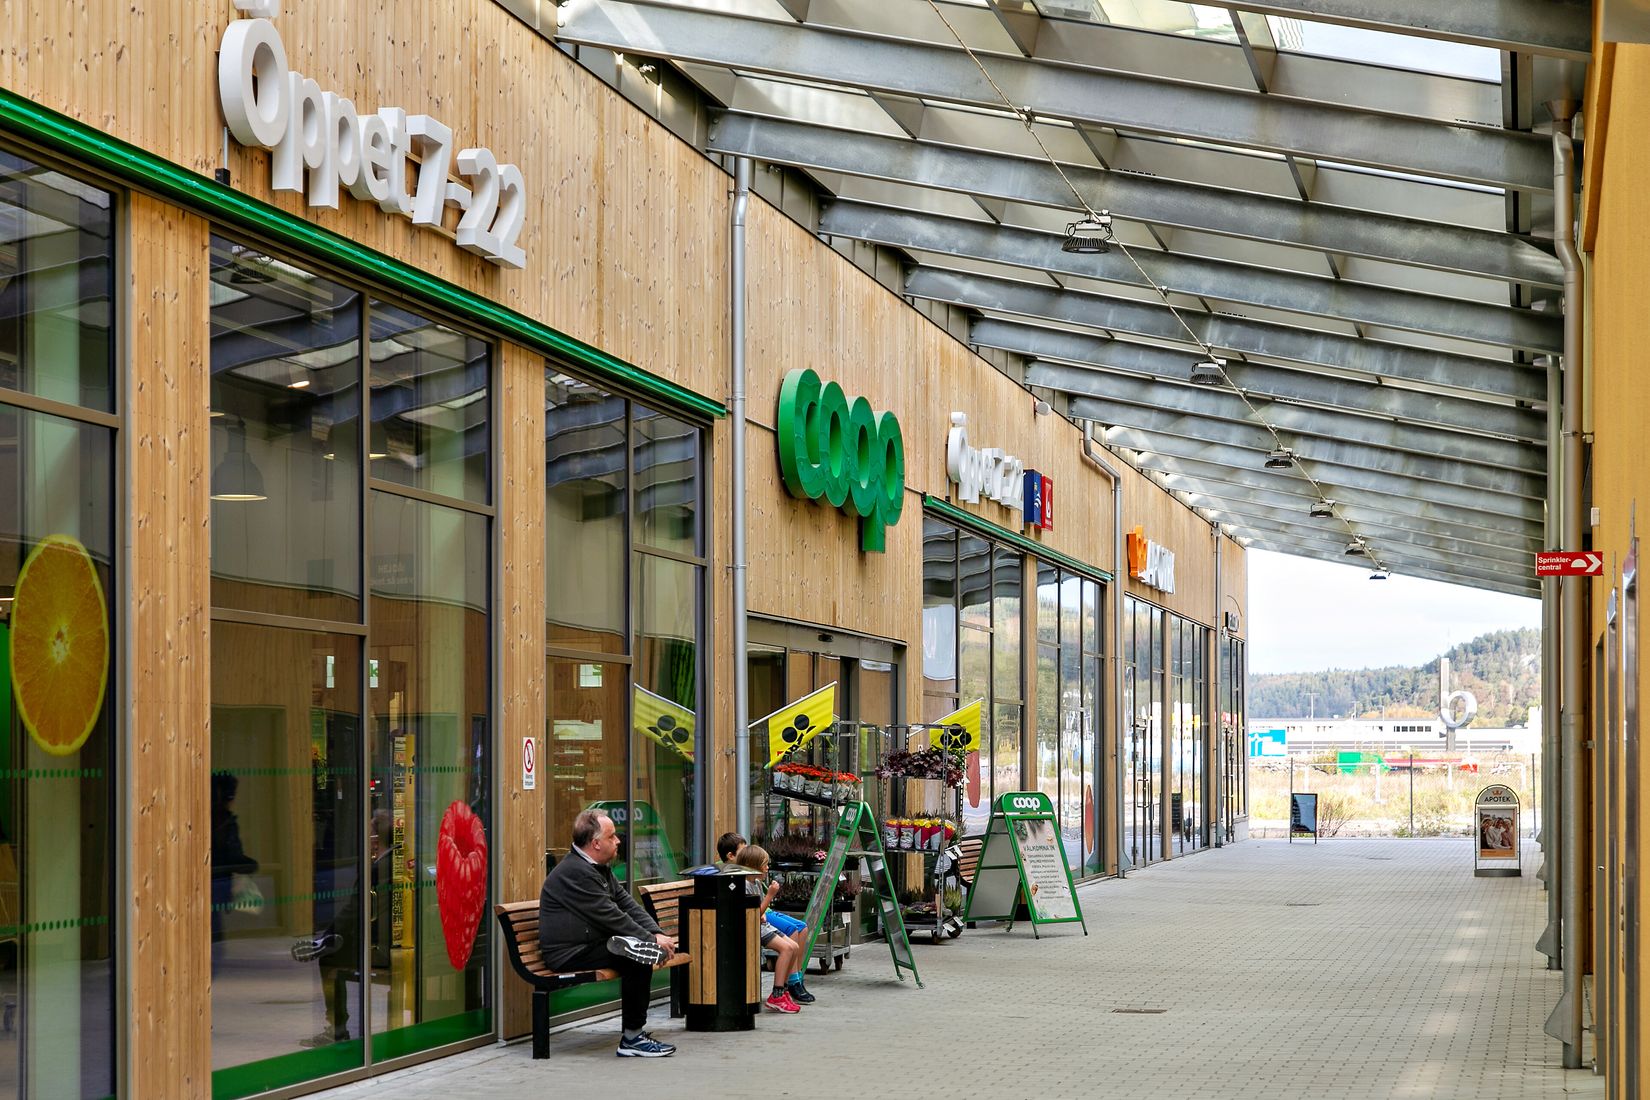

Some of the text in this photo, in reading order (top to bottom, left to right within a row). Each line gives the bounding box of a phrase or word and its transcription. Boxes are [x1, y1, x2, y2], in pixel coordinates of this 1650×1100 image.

[406, 115, 526, 269] 7-22
[778, 368, 904, 553] coop
[1538, 556, 1571, 564] Sprinkler-
[1538, 563, 1561, 571] central
[1013, 797, 1041, 810] coop
